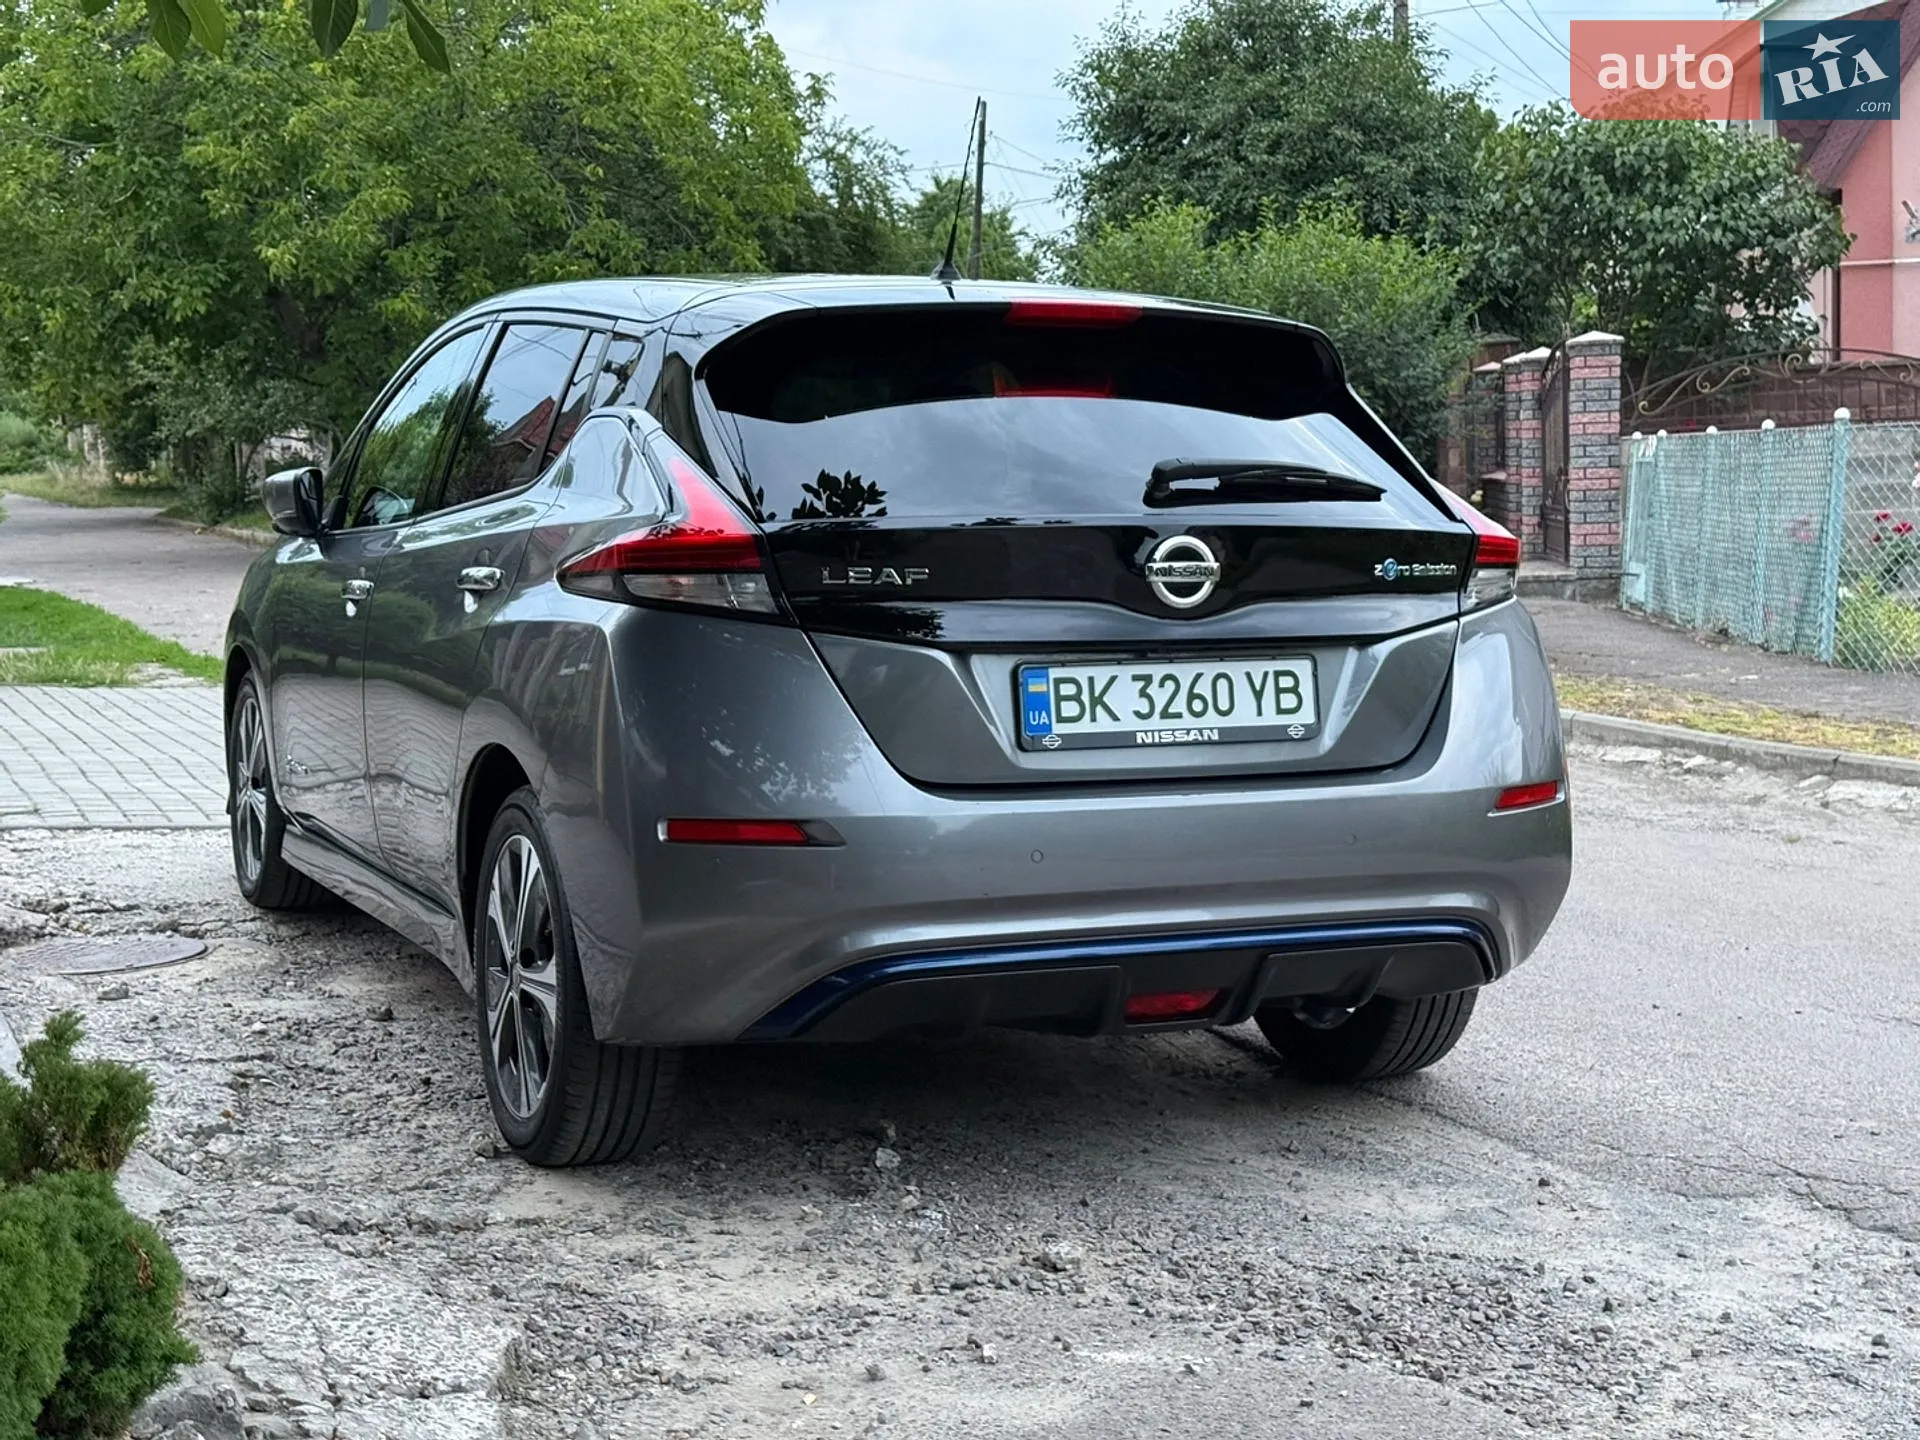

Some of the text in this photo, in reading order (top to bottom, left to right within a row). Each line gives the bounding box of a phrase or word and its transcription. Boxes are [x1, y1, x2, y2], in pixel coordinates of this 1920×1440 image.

[821, 566, 930, 585] LEAF
[1146, 564, 1215, 578] NISSAN
[1053, 669, 1304, 724] BK 3260 YB
[1029, 711, 1050, 726] UA
[1136, 728, 1219, 744] NISSAN
